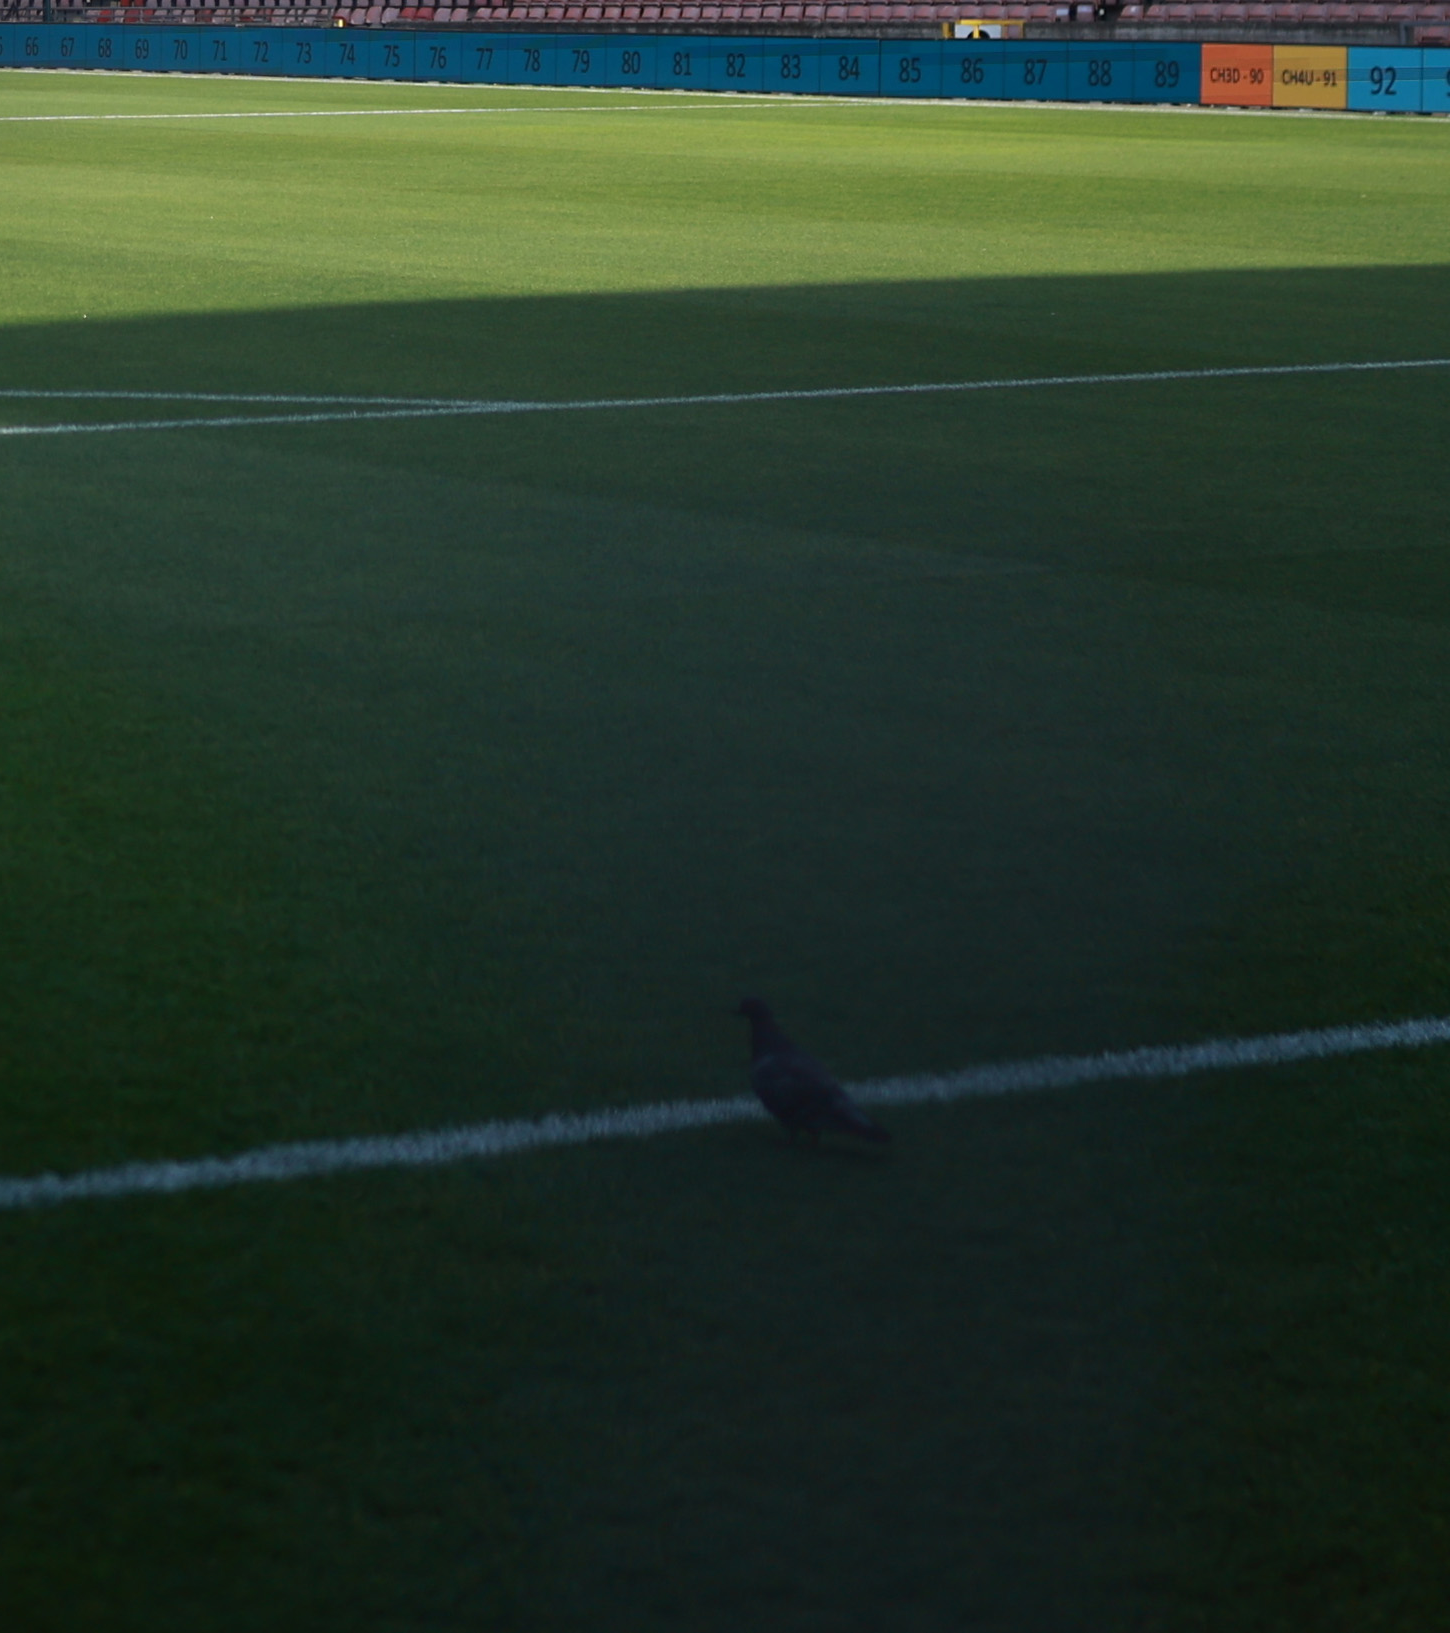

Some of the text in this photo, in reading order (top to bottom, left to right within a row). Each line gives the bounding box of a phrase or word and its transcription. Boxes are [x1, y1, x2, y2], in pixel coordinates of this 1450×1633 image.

[25, 37, 39, 56] 66
[61, 37, 74, 56] 67
[98, 38, 112, 58] 68
[135, 39, 149, 59] 69
[174, 39, 188, 60] 70
[213, 40, 227, 61] 71
[254, 41, 268, 62] 72
[296, 42, 311, 64] 73
[340, 44, 355, 64] 74
[384, 45, 400, 67] 75
[430, 46, 446, 69] 76
[476, 48, 493, 70] 77
[524, 49, 540, 72] 78
[572, 50, 590, 73] 79
[622, 51, 641, 74] 80
[673, 52, 692, 76] 81
[726, 53, 745, 78] 82
[781, 54, 801, 79] 83
[839, 56, 860, 81] 84
[899, 57, 920, 83] 85
[961, 58, 985, 84] 86
[1024, 59, 1047, 85] 87
[1088, 61, 1113, 87] 88
[1154, 62, 1180, 88] 89
[1210, 67, 1240, 83] CH3D
[1250, 68, 1264, 84] 90
[1282, 69, 1314, 85] CH4U
[1323, 70, 1337, 87] 91
[1370, 66, 1397, 95] 92
